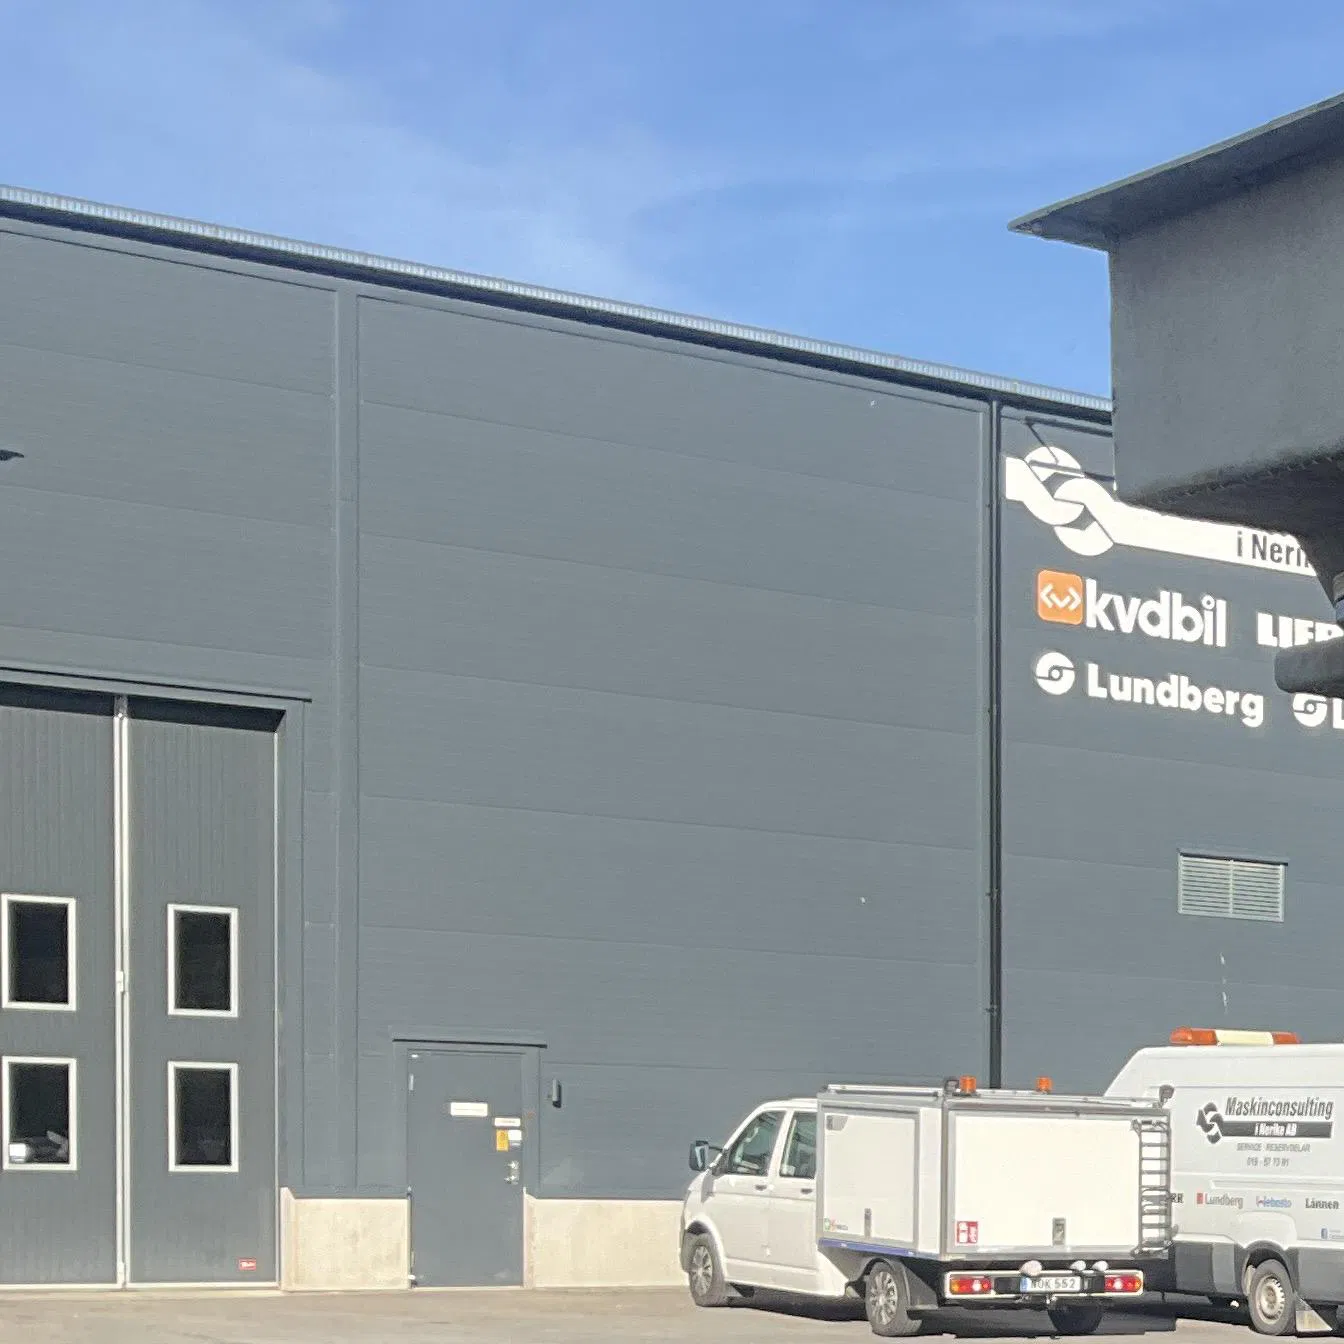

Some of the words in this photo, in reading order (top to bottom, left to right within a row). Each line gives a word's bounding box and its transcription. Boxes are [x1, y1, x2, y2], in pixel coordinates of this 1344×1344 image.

[1085, 578, 1228, 648] kvdbil
[1086, 662, 1264, 729] Lundberg
[1224, 1096, 1335, 1121] Maskinconsulting
[1205, 1193, 1244, 1209] Lundberg
